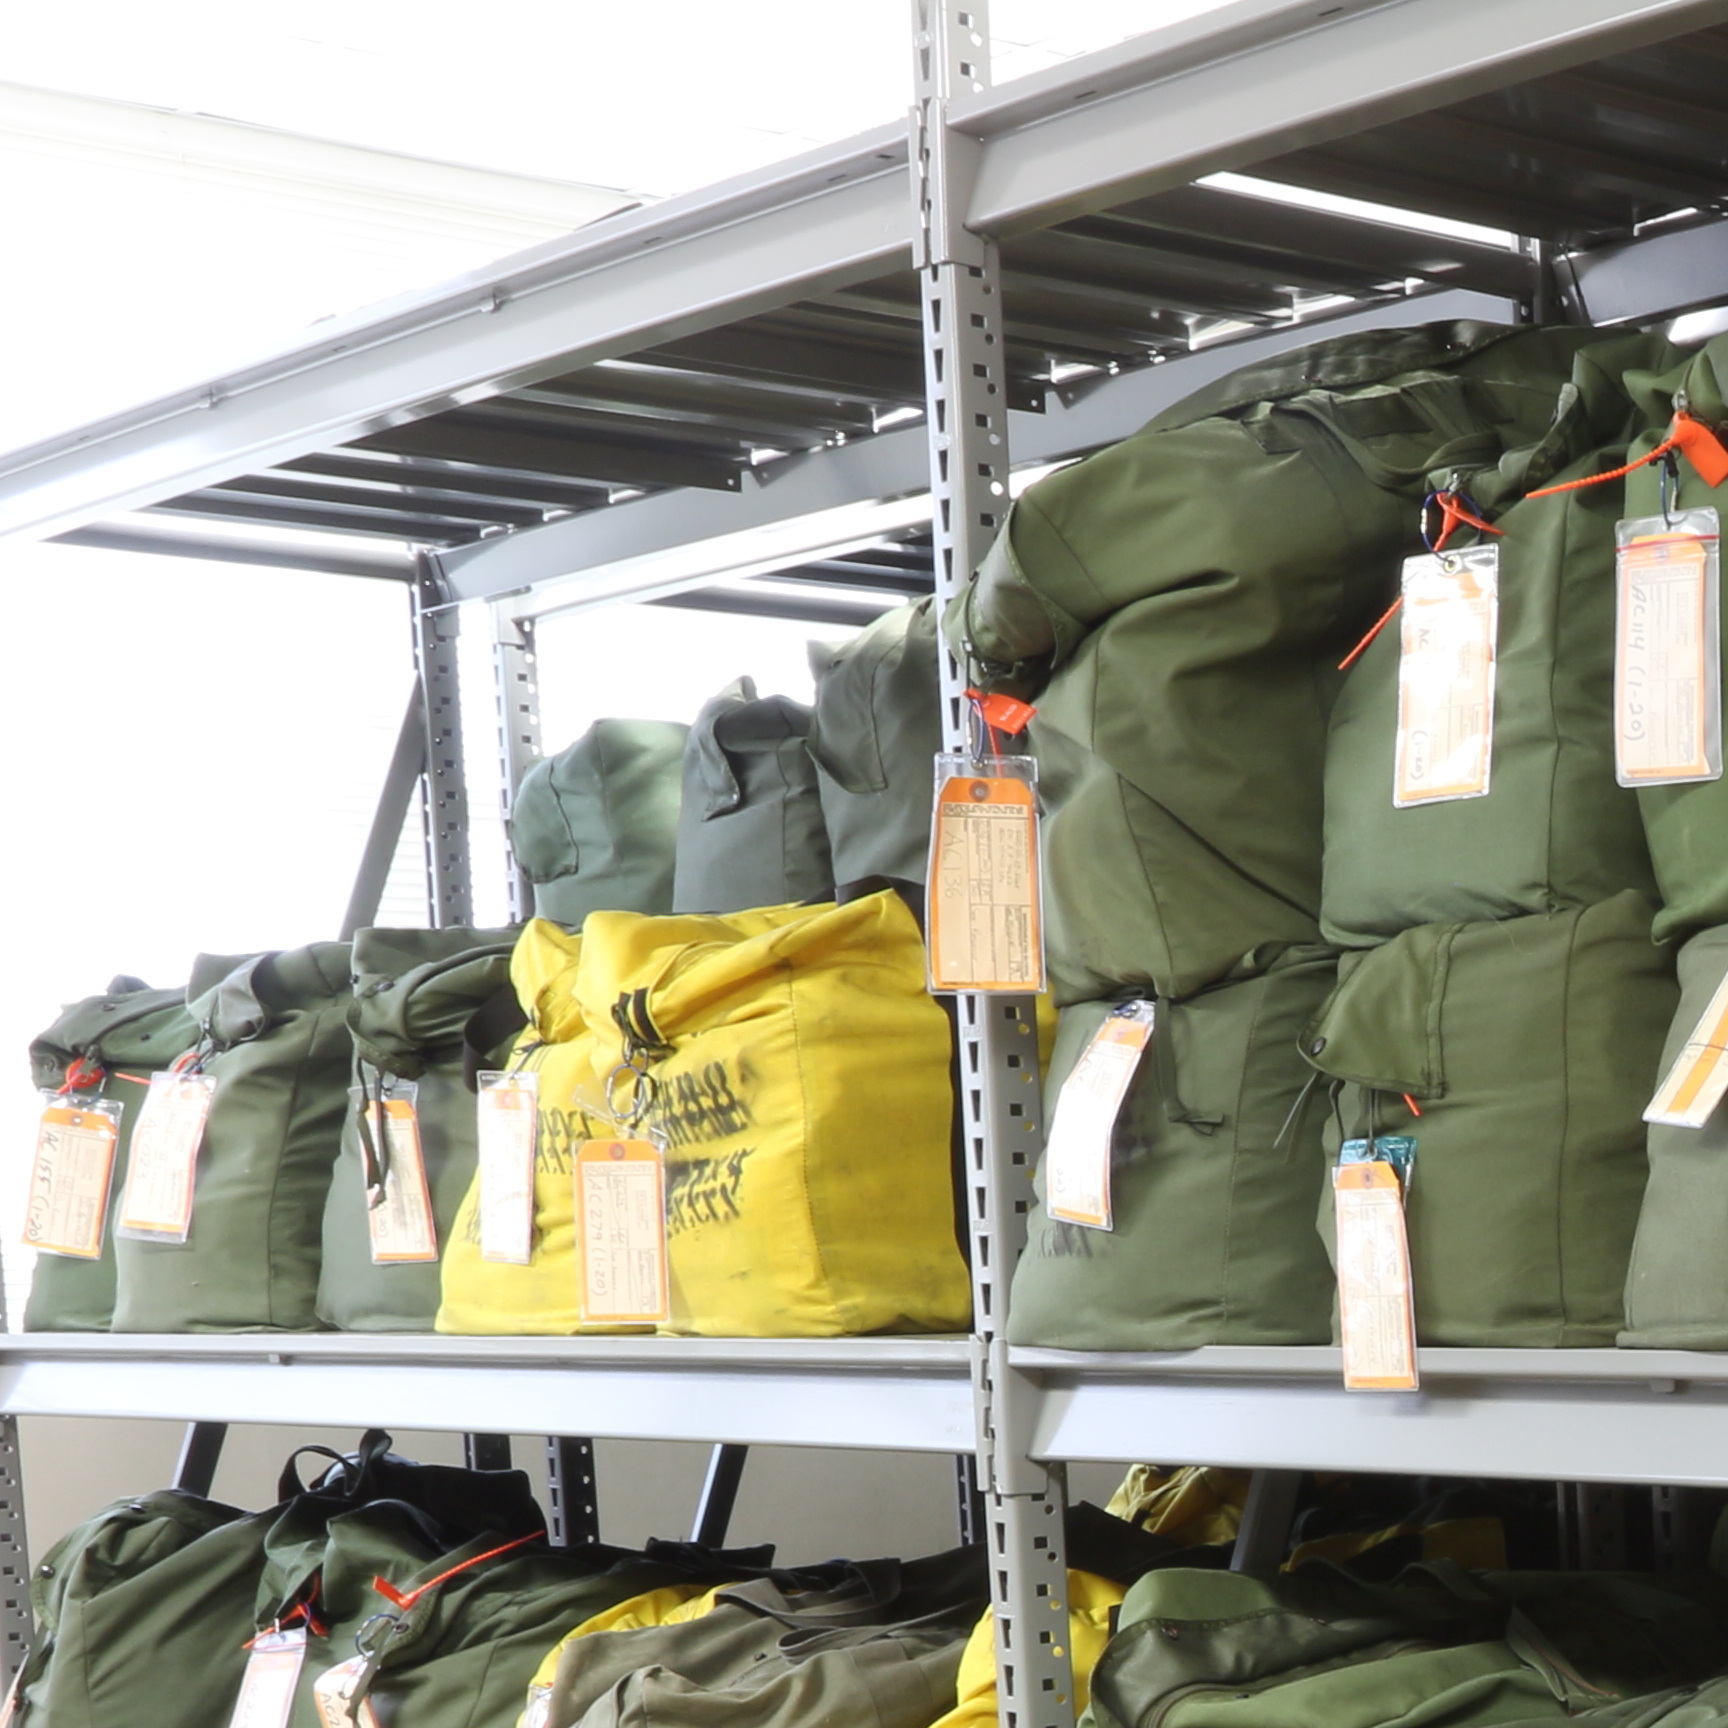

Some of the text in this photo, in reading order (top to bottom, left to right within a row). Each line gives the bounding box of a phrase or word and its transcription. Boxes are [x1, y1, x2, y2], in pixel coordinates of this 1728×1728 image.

[1623, 584, 1647, 742] AC114 (1-20)
[1409, 730, 1429, 780] (1-20)
[942, 829, 965, 900] AC136
